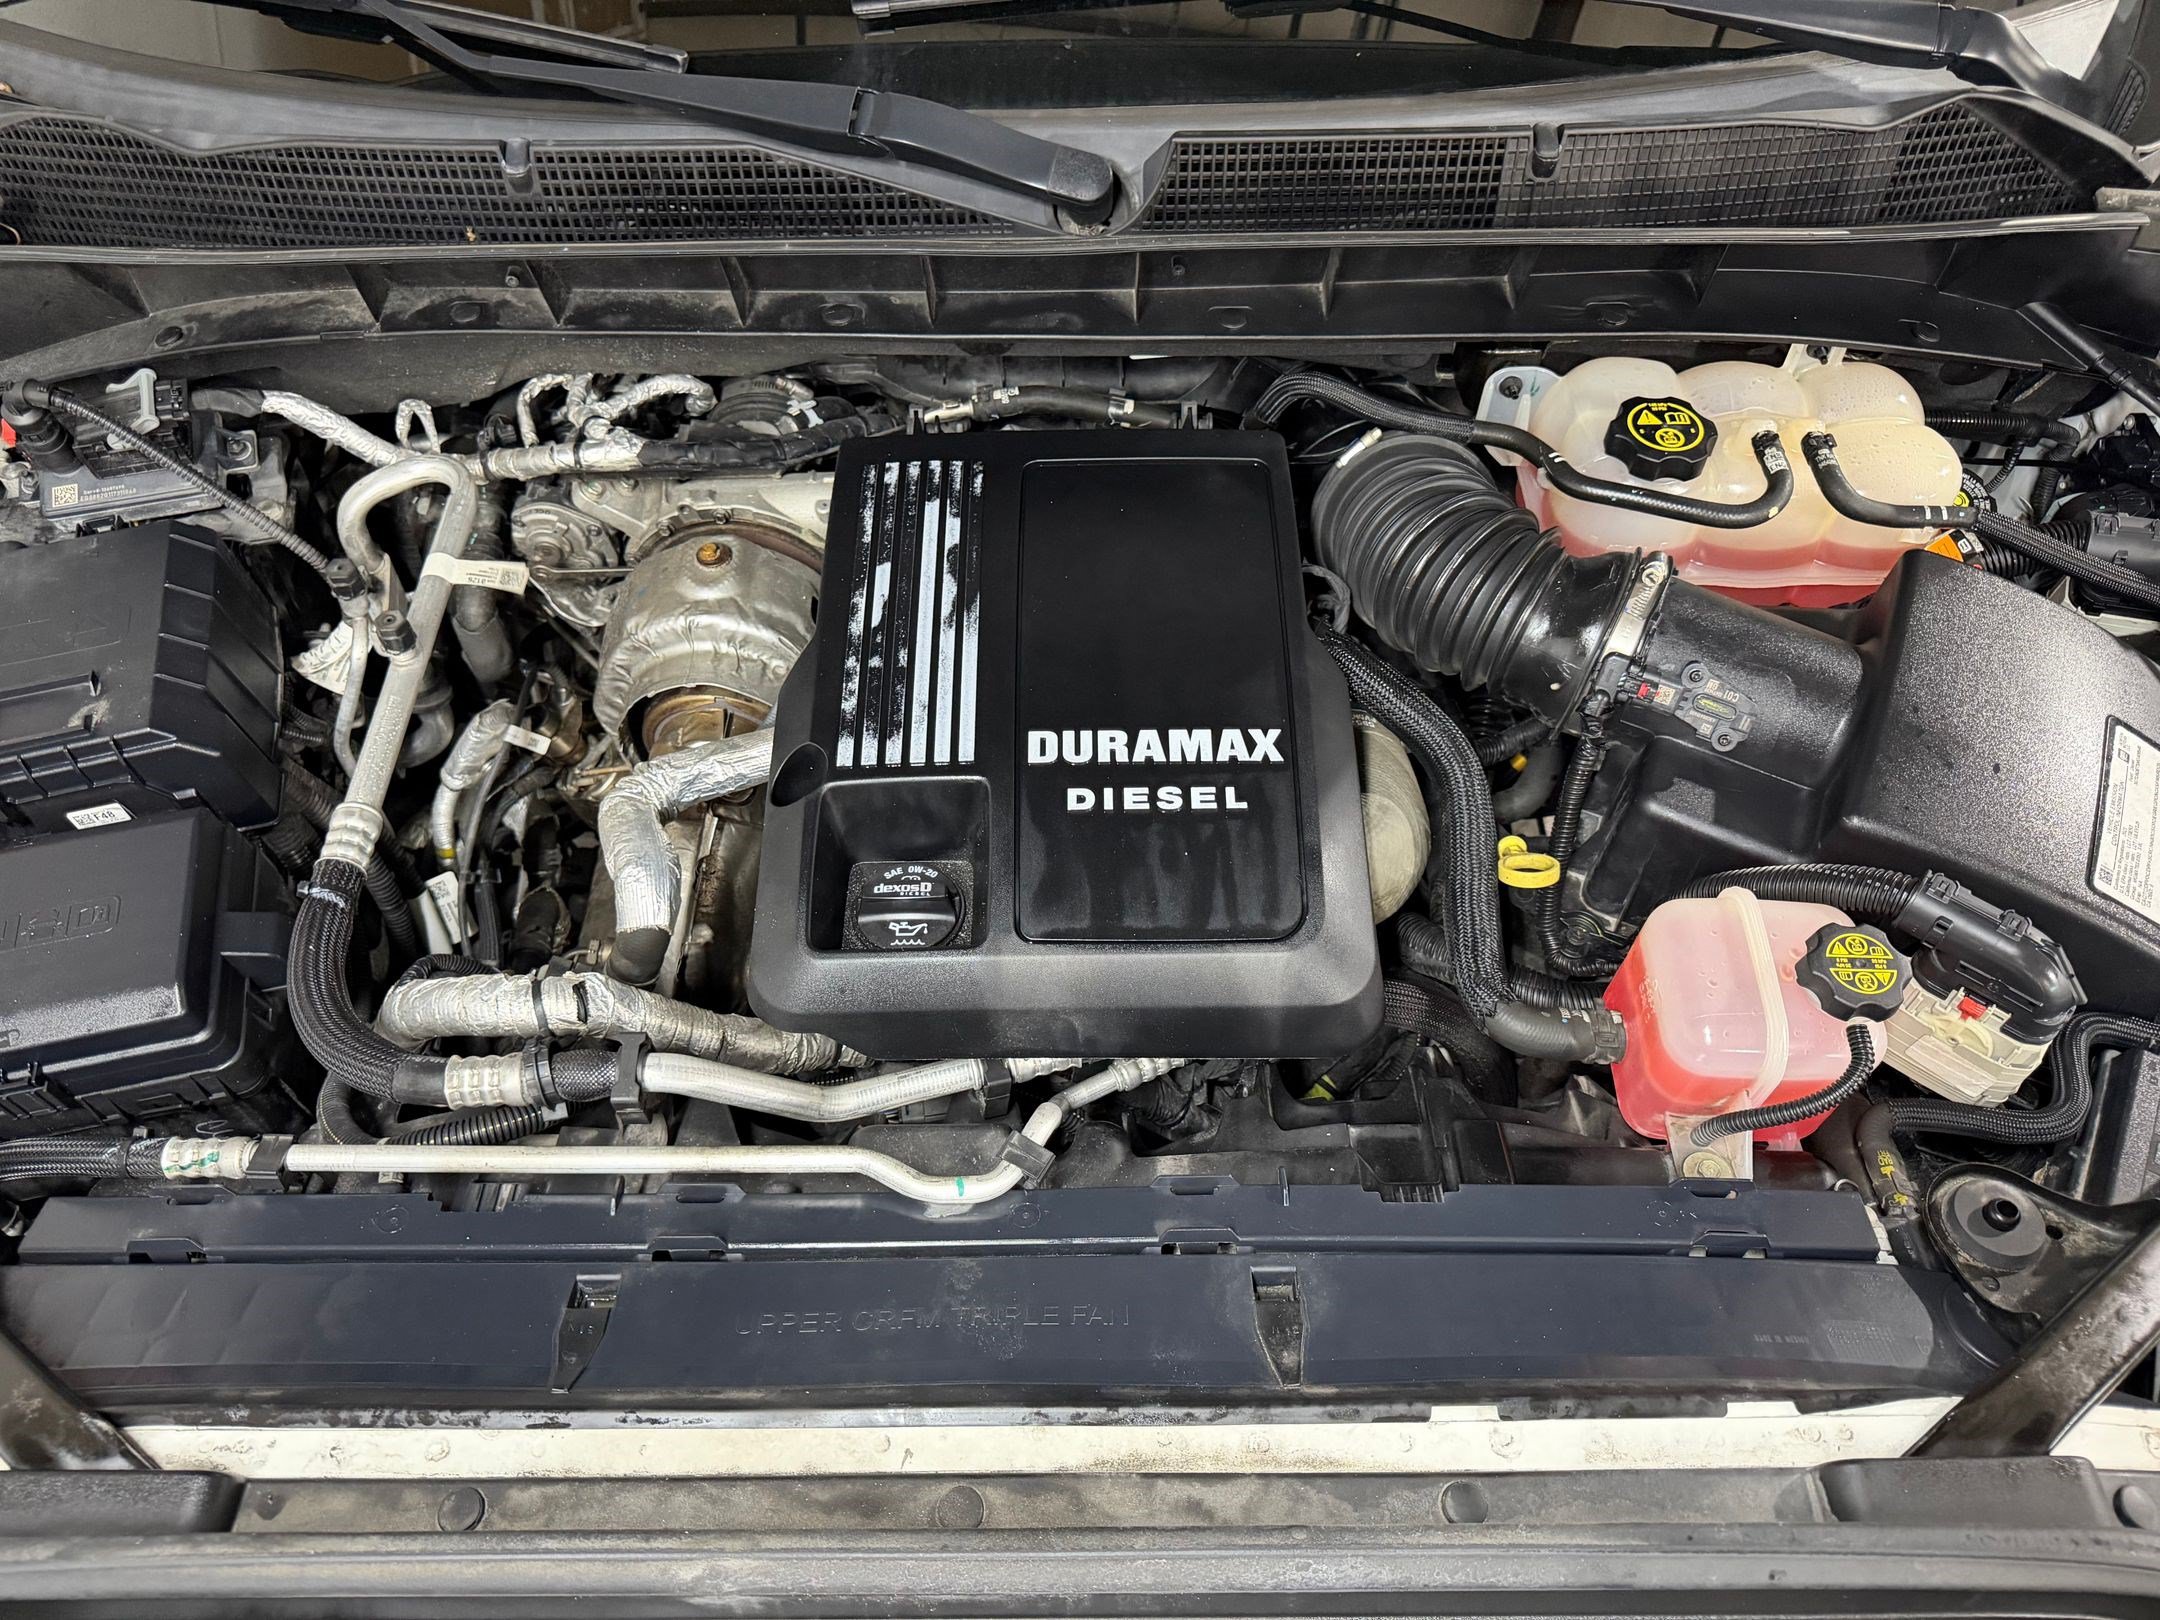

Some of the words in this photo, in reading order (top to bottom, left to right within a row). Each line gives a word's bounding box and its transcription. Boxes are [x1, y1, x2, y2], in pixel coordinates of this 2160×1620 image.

[1028, 729, 1284, 764] DURAMAX
[1067, 786, 1248, 812] DIESEL
[884, 867, 903, 879] SAE
[908, 866, 938, 878] 0W-20
[736, 1311, 843, 1334] UPPER
[951, 1305, 1060, 1327] TRIPLE
